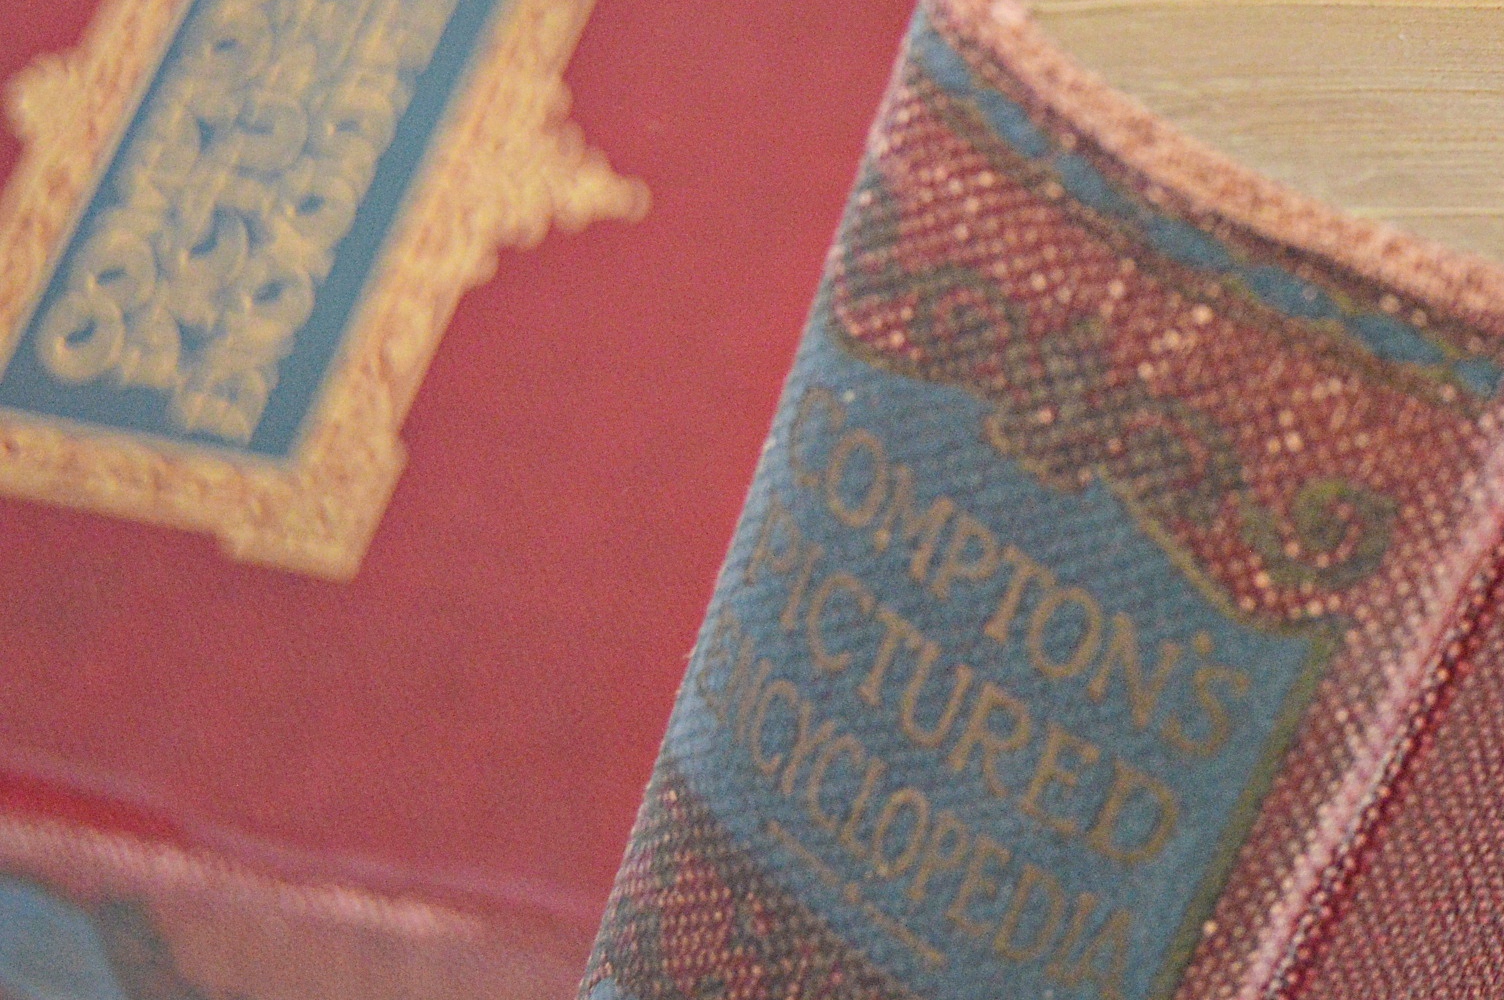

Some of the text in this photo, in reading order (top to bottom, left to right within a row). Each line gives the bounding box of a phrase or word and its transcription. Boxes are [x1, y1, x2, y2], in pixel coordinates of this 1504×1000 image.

[743, 492, 1178, 866] PICTURED
[789, 384, 1250, 757] COMPTON'S
[697, 603, 1132, 998] ENCYCLOPEDIA
